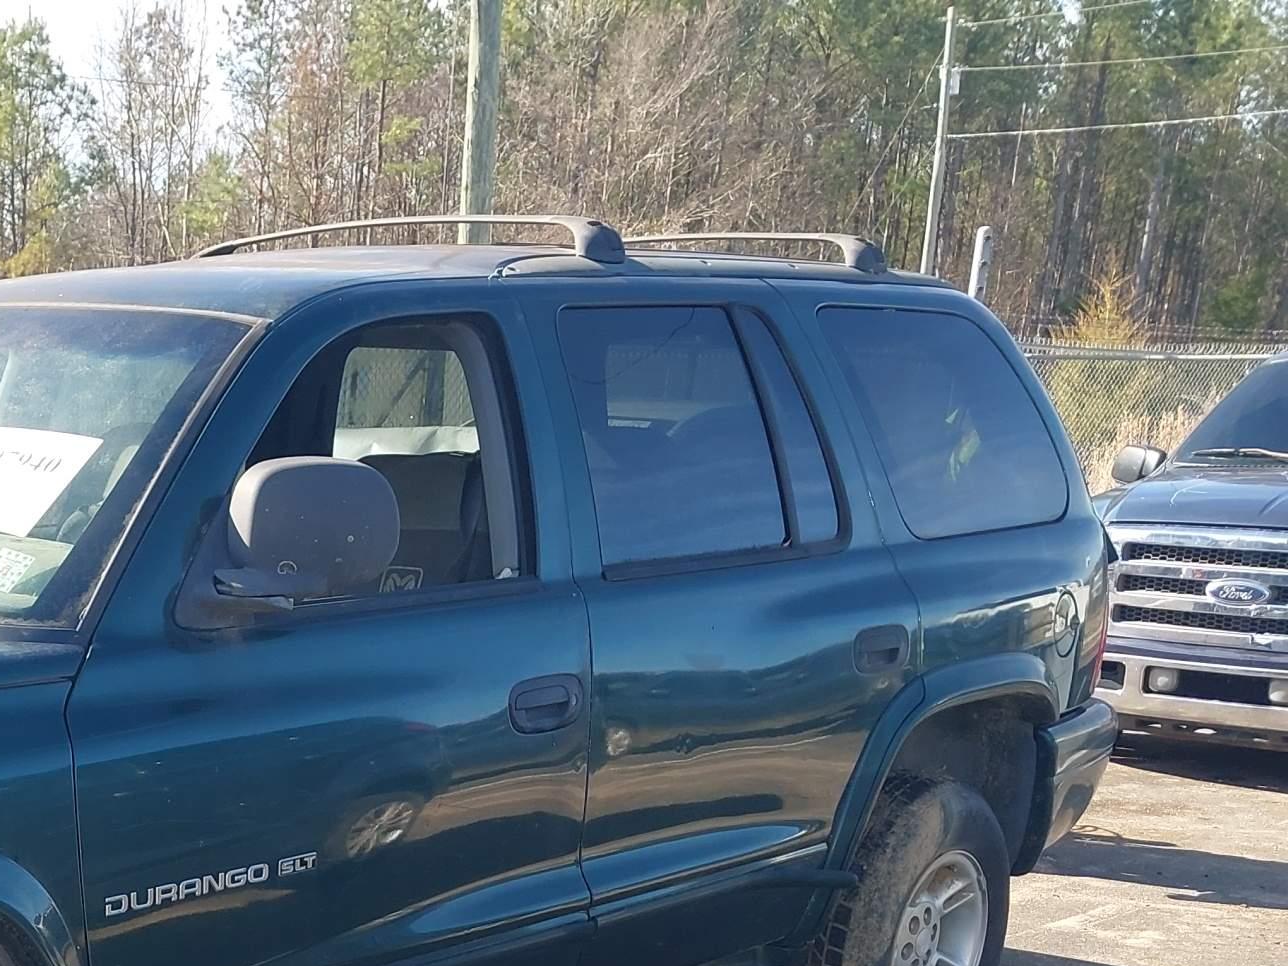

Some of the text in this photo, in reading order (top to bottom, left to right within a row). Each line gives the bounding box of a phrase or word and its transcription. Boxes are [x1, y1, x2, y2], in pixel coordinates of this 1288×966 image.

[1219, 585, 1253, 600] Ford
[104, 854, 318, 917] DURANGO SLT
